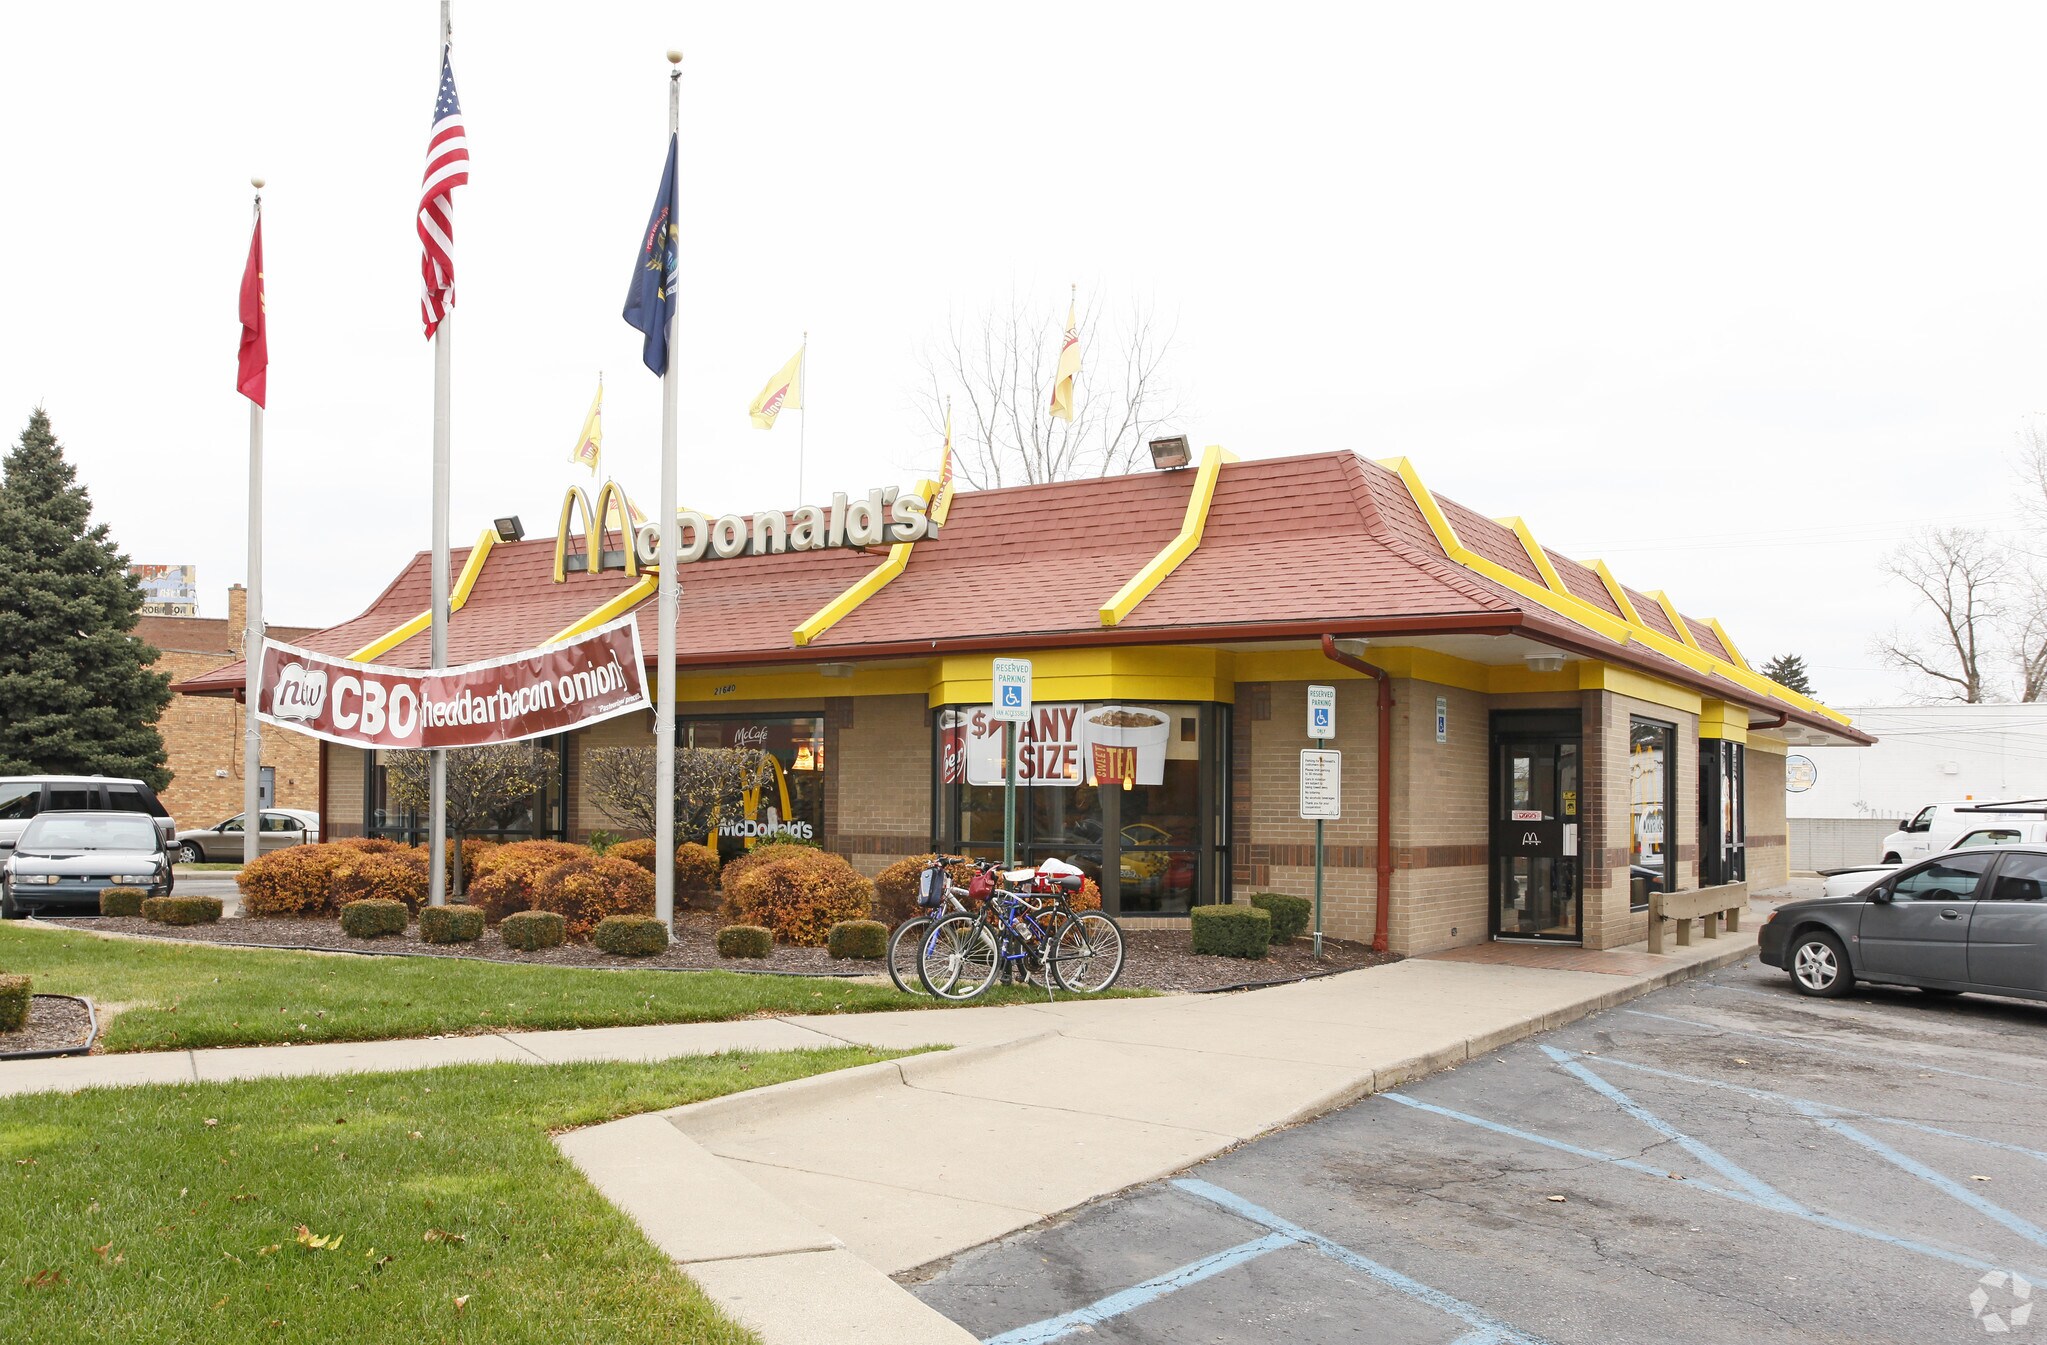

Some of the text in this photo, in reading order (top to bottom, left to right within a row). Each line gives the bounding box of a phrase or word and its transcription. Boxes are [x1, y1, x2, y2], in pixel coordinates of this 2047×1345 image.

[996, 664, 1029, 673] RESERVED
[998, 674, 1026, 683] PARKING
[714, 684, 736, 696] 21640
[1310, 690, 1333, 698] RESERVED
[331, 675, 417, 739] CBO
[499, 679, 554, 720] bacon
[734, 725, 769, 747] McCafé
[1018, 708, 1079, 743] ANY
[1018, 744, 1079, 780] SIZE
[1094, 744, 1107, 778] SWEET
[1106, 747, 1135, 779] TEA
